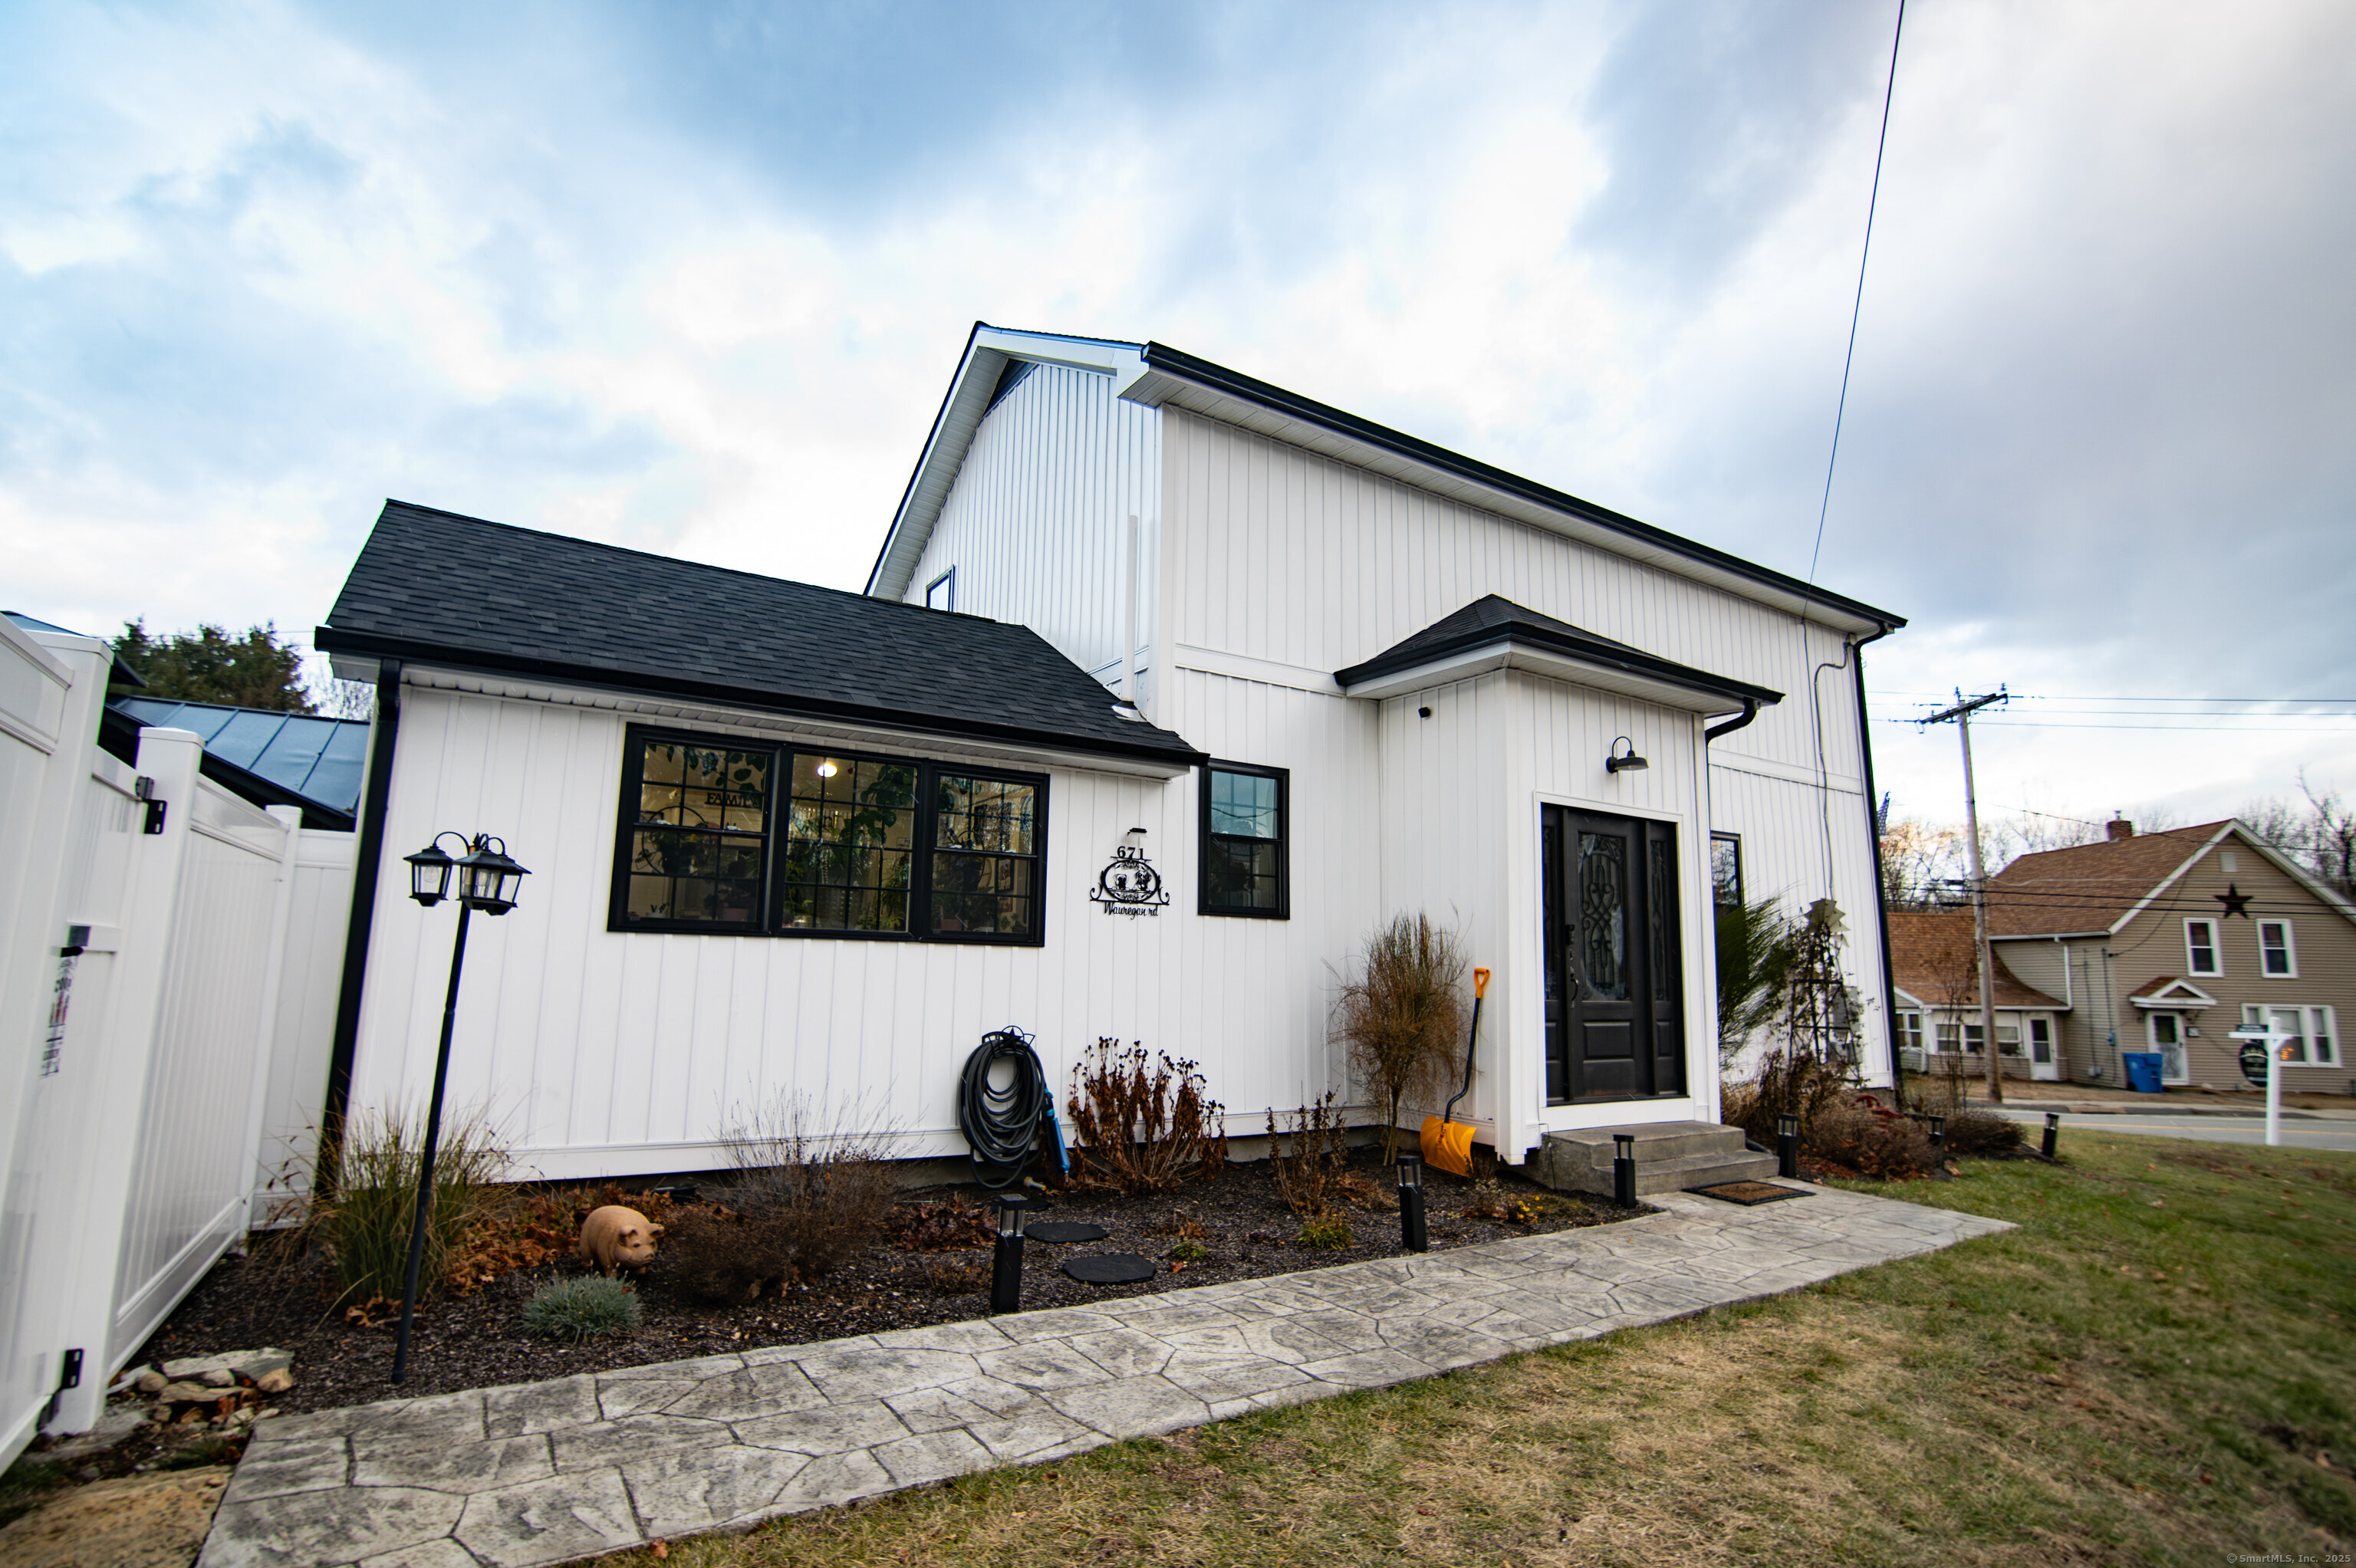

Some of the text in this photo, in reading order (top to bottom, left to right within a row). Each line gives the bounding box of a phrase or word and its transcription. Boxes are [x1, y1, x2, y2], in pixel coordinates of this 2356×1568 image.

[705, 791, 760, 808] FAMIL
[1117, 846, 1143, 860] 671
[1104, 901, 1159, 920] Wauregan rd
